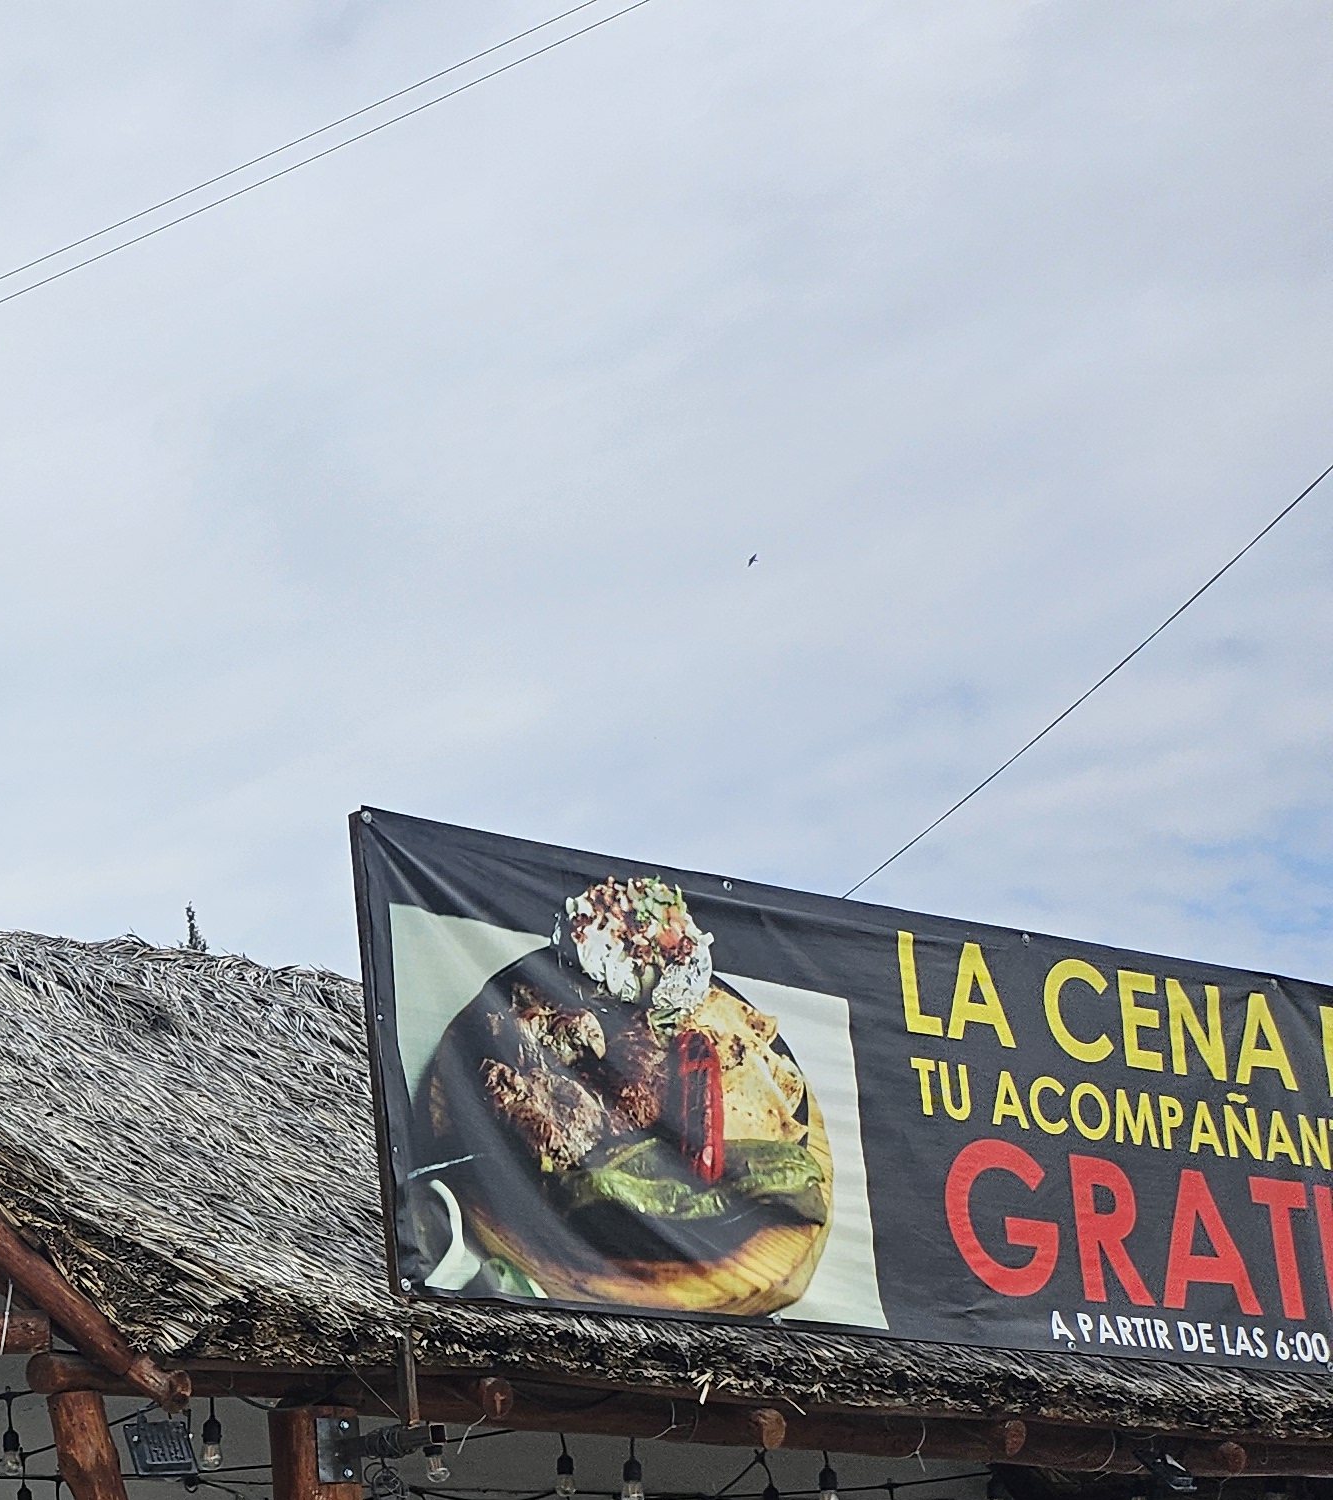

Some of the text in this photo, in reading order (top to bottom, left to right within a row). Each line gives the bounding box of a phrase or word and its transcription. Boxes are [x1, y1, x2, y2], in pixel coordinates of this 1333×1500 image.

[897, 931, 1016, 1047] LA
[1044, 958, 1298, 1092] CENA
[910, 1057, 1333, 1170] TU ACOMPAÑAN
[1052, 1310, 1330, 1363] A PARTIR DE LAS 6:00
